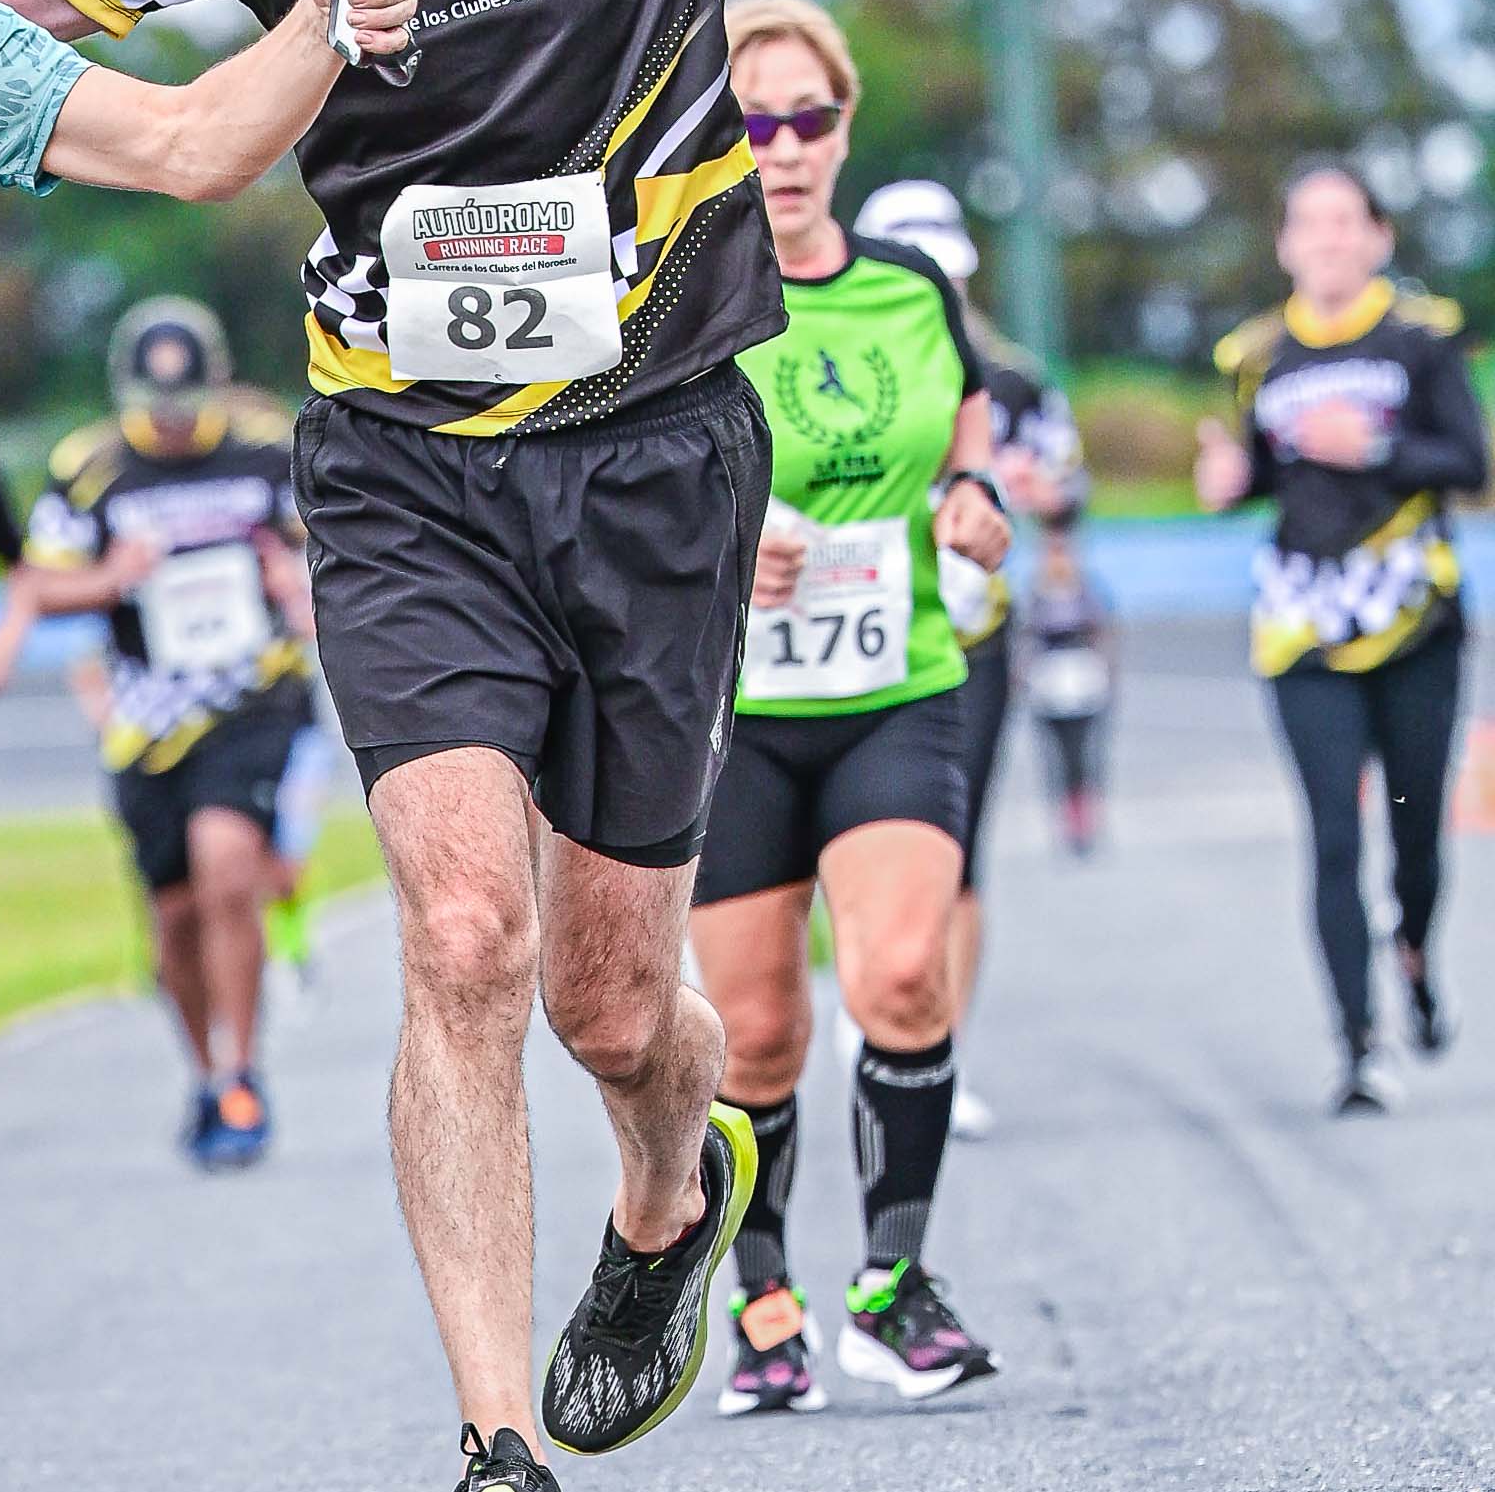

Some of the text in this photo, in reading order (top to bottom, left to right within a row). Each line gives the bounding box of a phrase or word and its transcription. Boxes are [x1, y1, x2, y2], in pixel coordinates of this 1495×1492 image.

[421, 10, 449, 28] los
[413, 198, 574, 240] AUTÓDROMO
[438, 237, 549, 258] RUNNING RACE
[415, 257, 577, 273] La Carrera de los Clubes del Noroeste
[447, 285, 554, 350] 82
[769, 608, 885, 665] 176
